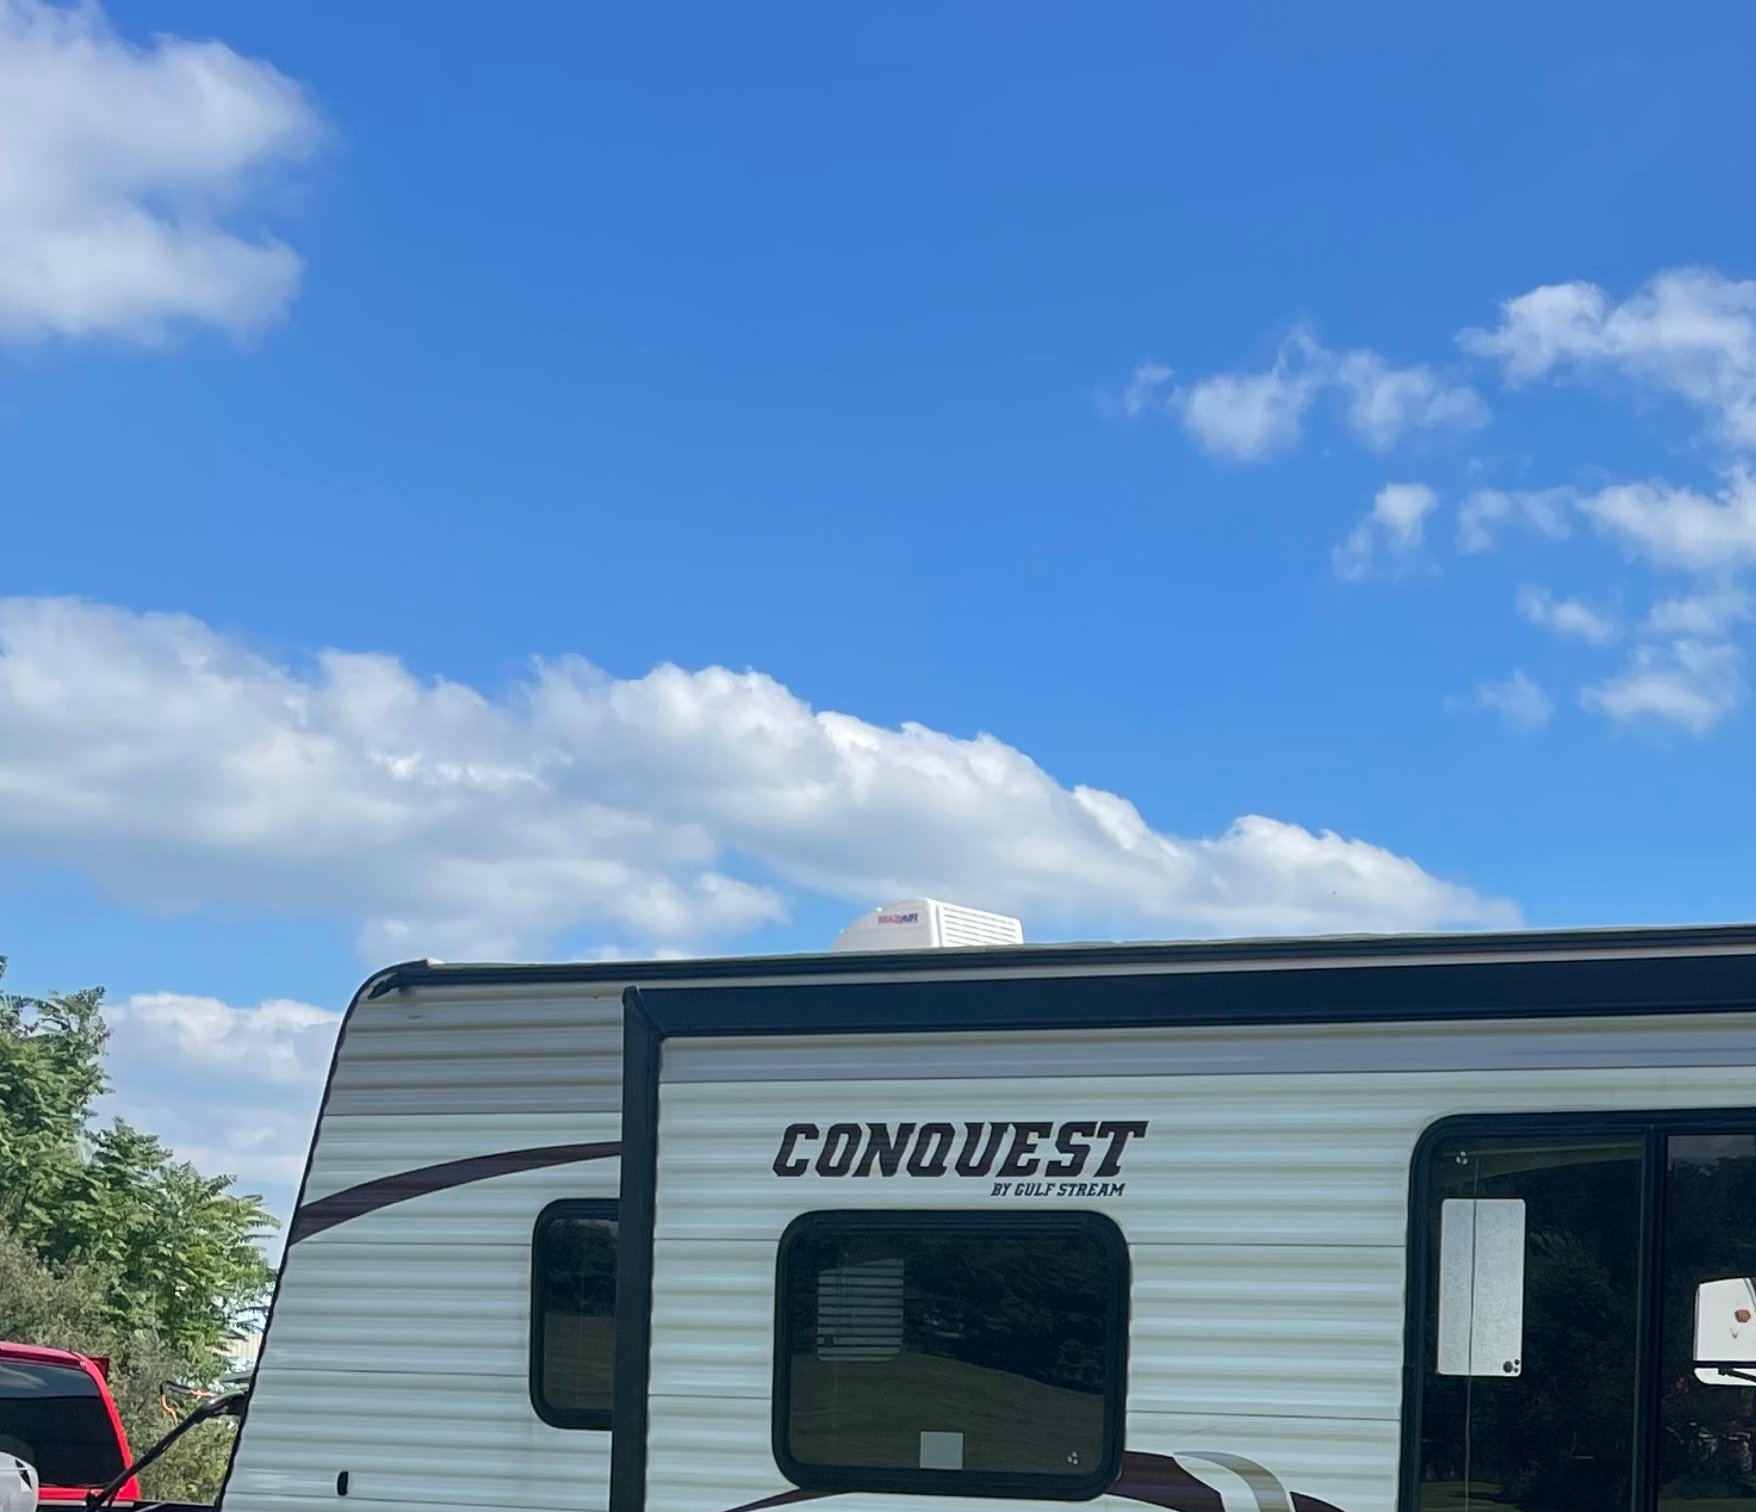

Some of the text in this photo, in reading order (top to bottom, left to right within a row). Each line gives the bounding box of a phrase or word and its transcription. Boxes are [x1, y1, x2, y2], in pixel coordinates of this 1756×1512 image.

[772, 1120, 1150, 1178] CONQUEST
[991, 1182, 1126, 1198] BY GULF STREAM
